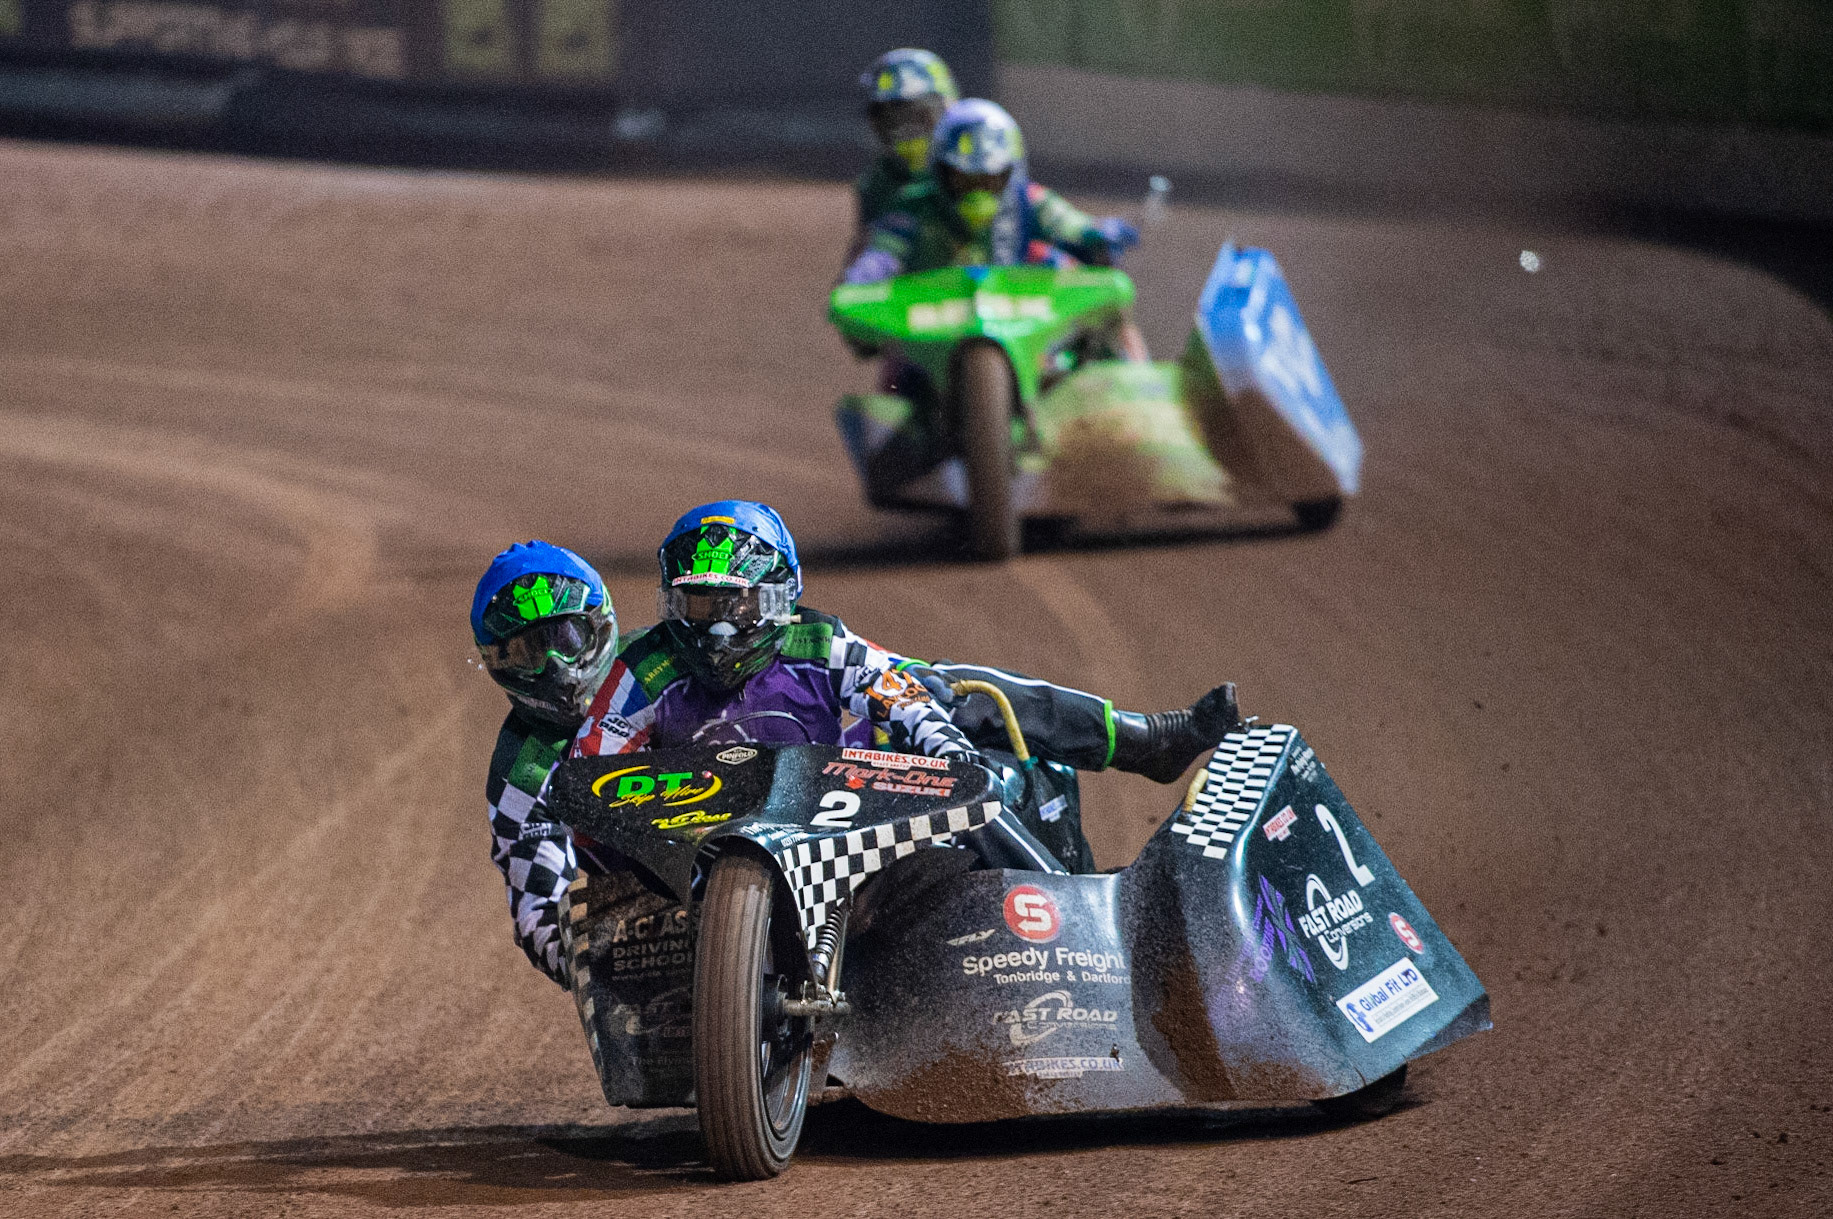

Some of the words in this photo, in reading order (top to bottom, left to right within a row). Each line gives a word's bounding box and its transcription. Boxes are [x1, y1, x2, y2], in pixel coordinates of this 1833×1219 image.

[843, 749, 948, 769] INTABIKES.CO.UK
[617, 771, 693, 798] DT
[872, 781, 952, 797] SUZUKI
[810, 790, 861, 828] 2
[1315, 804, 1376, 887] 2
[1299, 906, 1331, 939] FAST
[1327, 889, 1364, 923] ROAD
[1324, 911, 1374, 943] Conversions
[962, 948, 1049, 976] Speedy
[1056, 947, 1126, 973] Freight
[994, 971, 1060, 985] Tonbridge
[1066, 971, 1076, 982] &
[1385, 978, 1402, 995] Fit
[1057, 1007, 1118, 1022] ROAD
